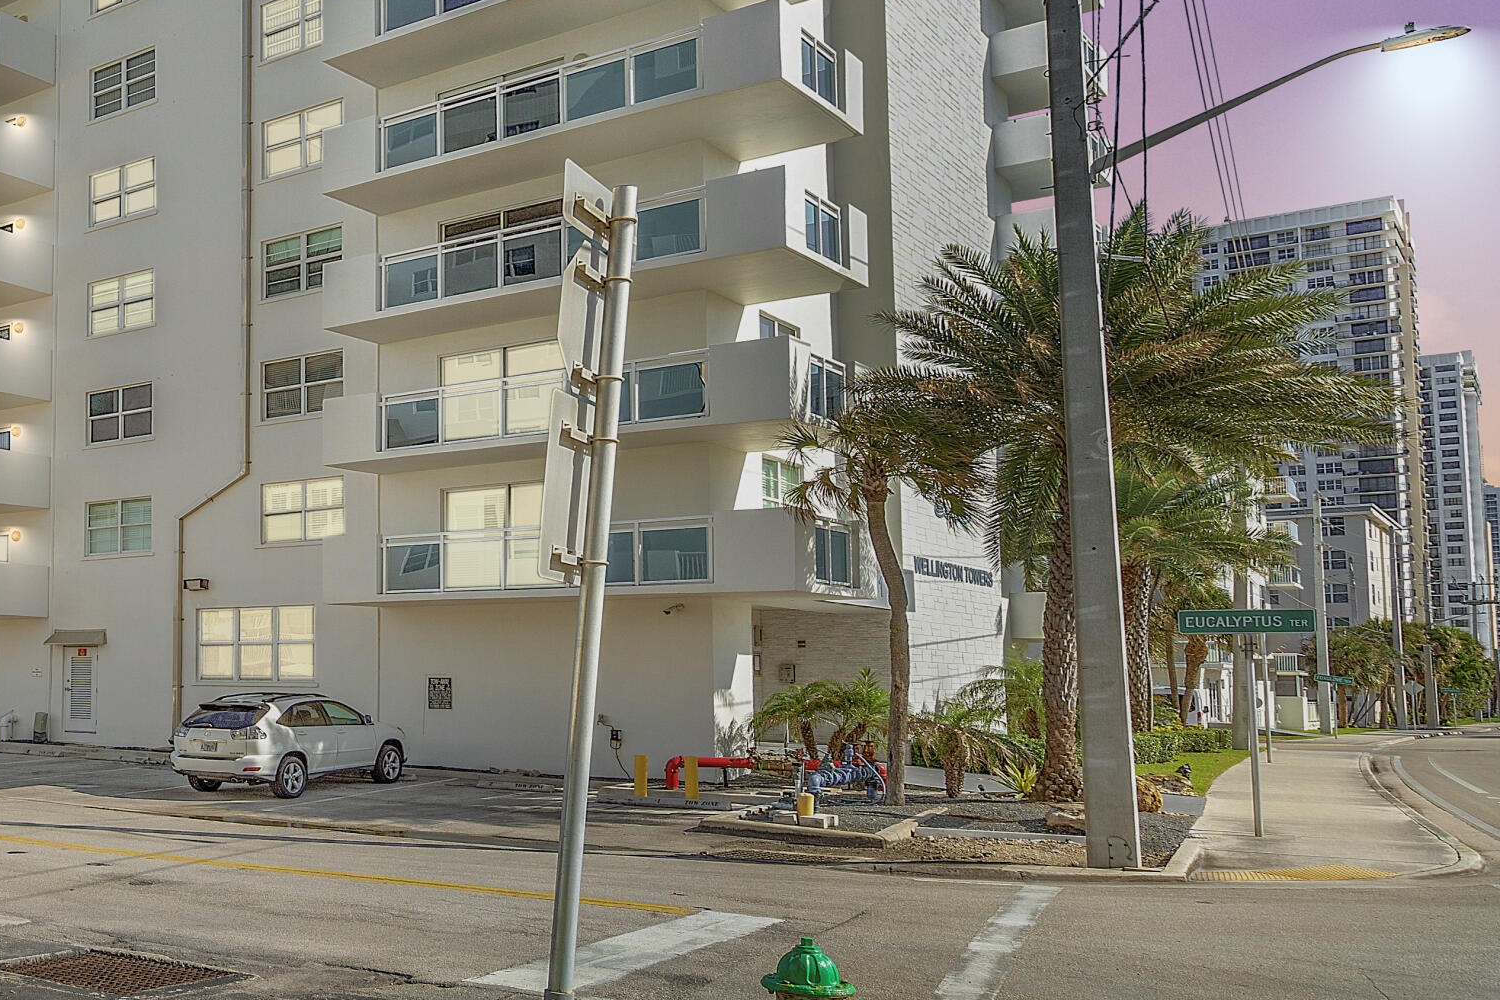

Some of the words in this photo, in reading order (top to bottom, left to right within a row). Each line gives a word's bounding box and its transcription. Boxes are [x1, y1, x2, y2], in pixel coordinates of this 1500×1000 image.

[913, 556, 963, 582] WELLINGTON
[964, 566, 993, 588] TOWERS
[1185, 616, 1282, 628] EUCALYPTUS
[1289, 619, 1308, 627] TER
